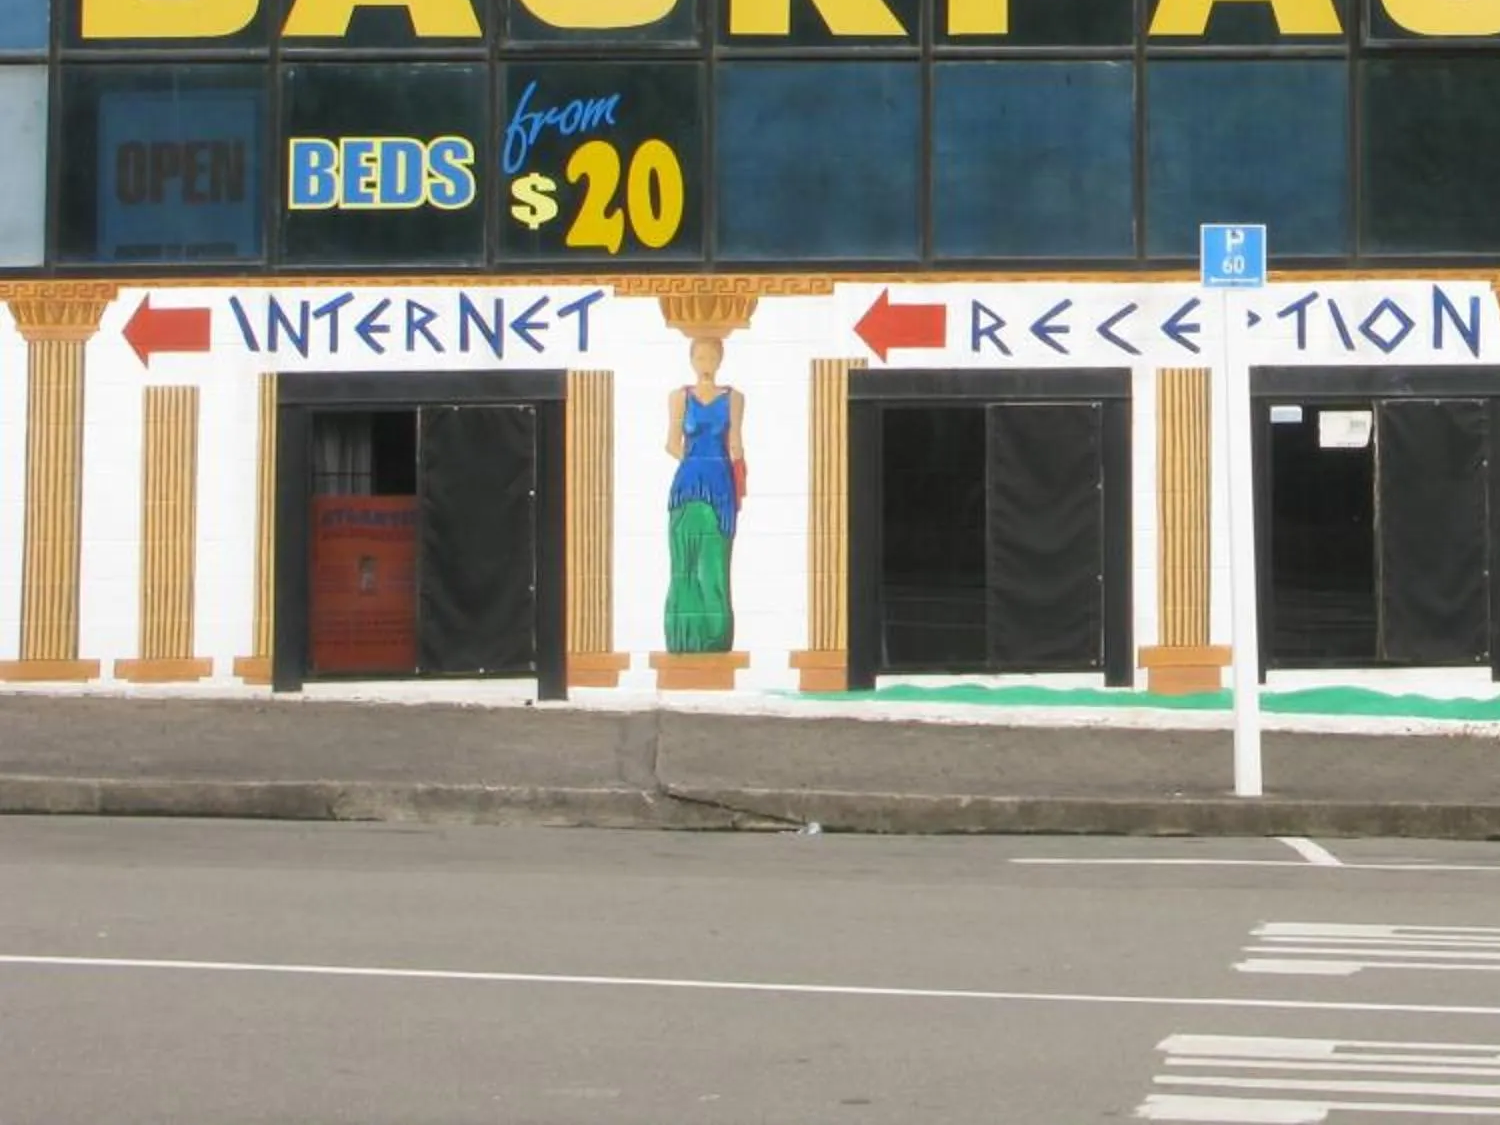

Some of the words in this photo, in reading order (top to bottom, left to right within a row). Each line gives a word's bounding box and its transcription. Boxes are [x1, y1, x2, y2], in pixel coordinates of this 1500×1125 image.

[504, 80, 618, 174] from
[116, 139, 246, 203] OPEN
[288, 137, 475, 210] BEDS
[1222, 255, 1246, 275] 60
[1225, 229, 1245, 253] P
[229, 290, 604, 359] INTERNET
